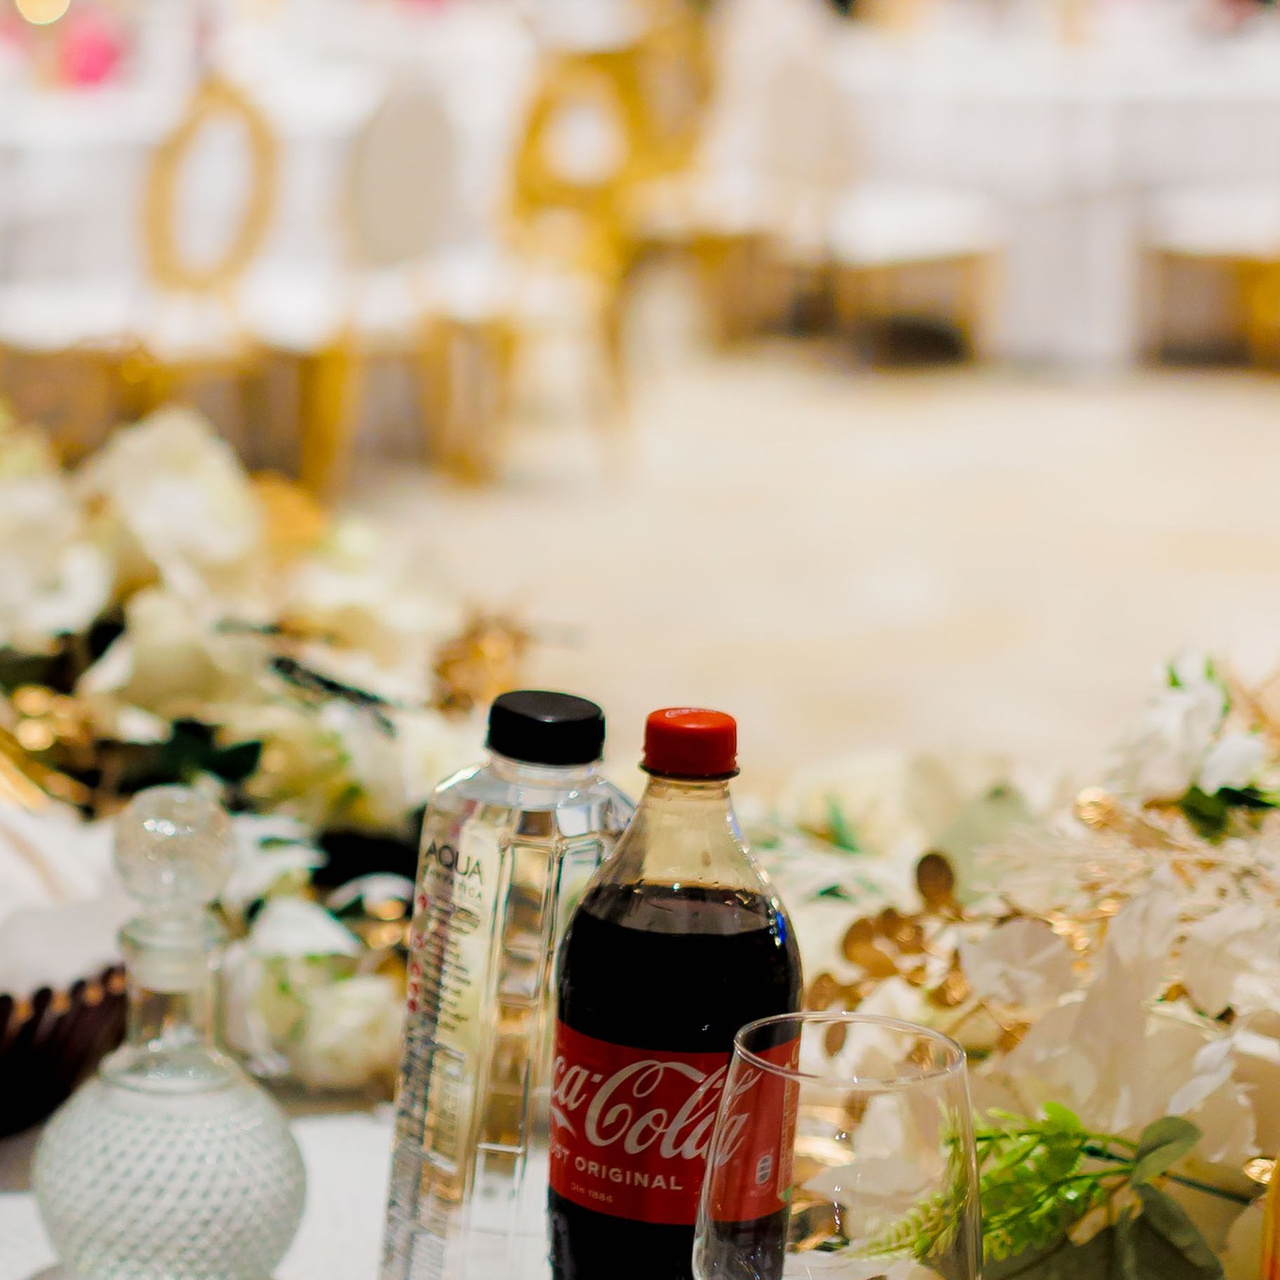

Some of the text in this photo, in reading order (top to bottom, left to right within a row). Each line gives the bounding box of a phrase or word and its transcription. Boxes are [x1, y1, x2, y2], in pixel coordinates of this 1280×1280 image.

[425, 839, 484, 886] AQUA
[574, 1156, 684, 1191] ORIGINAL
[588, 1190, 613, 1203] 1886
